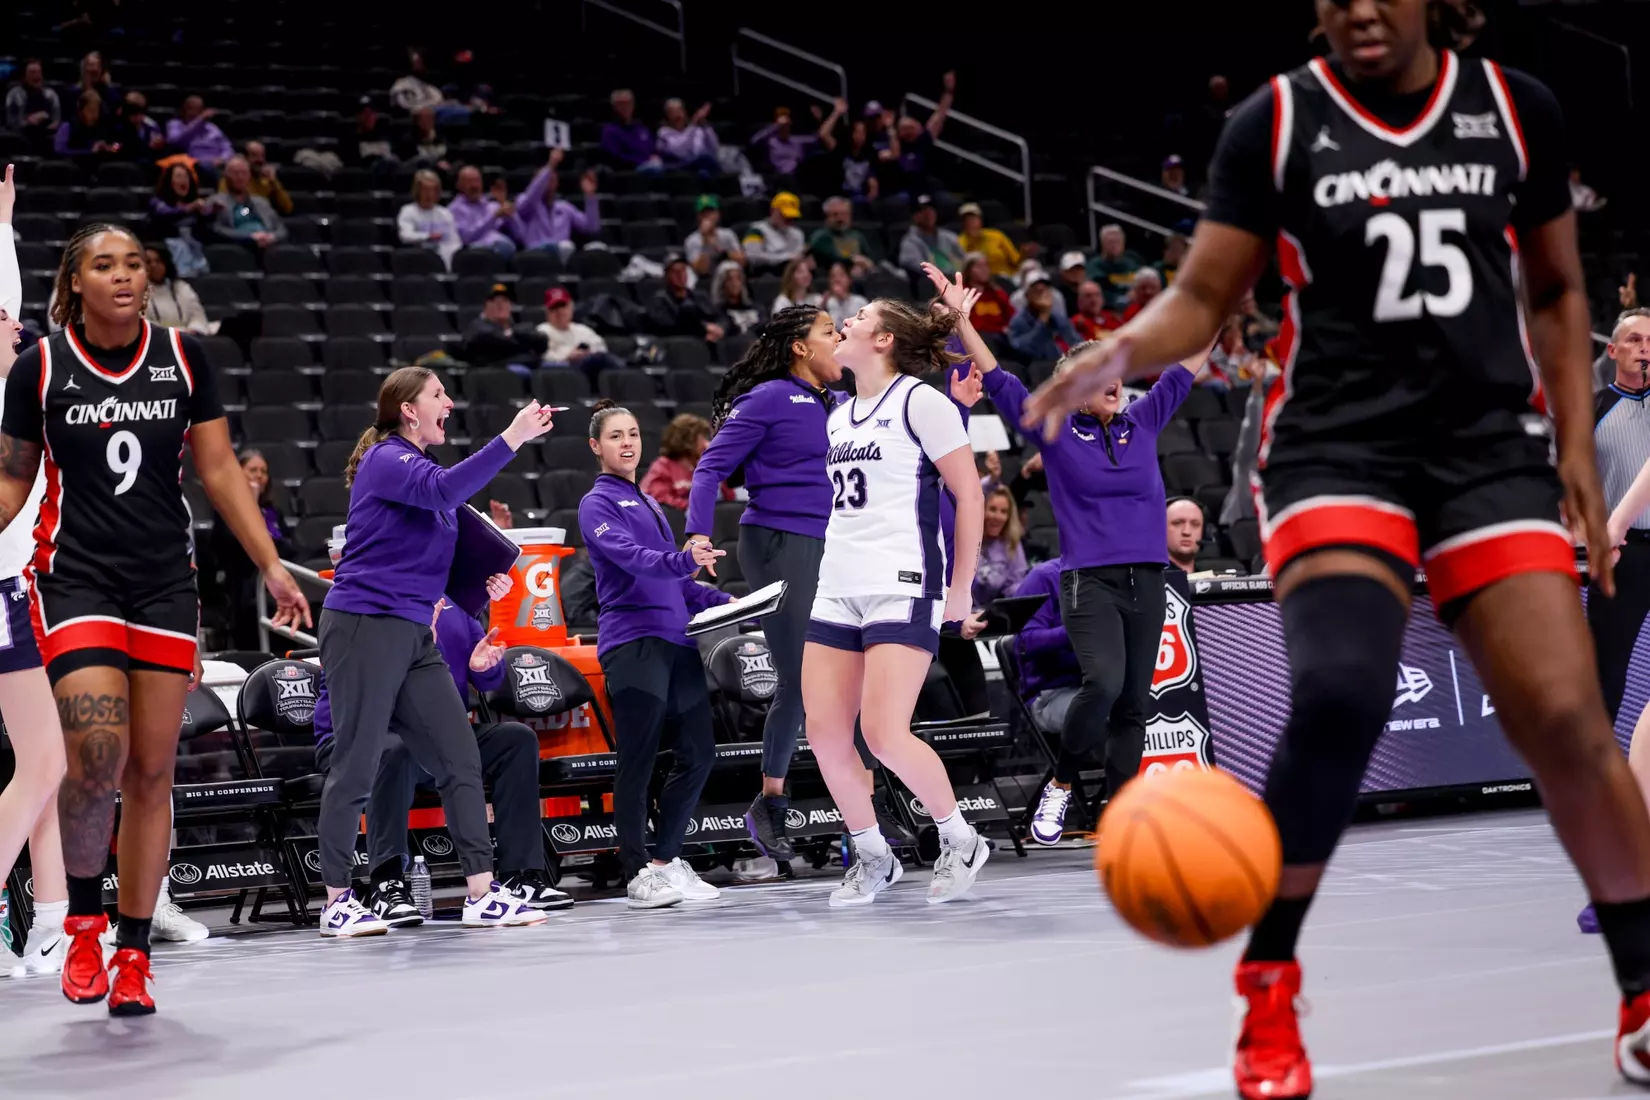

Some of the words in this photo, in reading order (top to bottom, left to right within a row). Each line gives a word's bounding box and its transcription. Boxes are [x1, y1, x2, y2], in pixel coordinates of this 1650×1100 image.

[1314, 159, 1497, 207] CINCINNATI
[1364, 208, 1474, 323] 25
[148, 365, 178, 382] XII
[65, 396, 177, 425] CINCINNATI
[105, 430, 142, 496] 9
[826, 440, 883, 466] Wildcats
[832, 466, 868, 512] 23
[525, 561, 555, 598] G
[1155, 631, 1176, 671] 6
[739, 653, 774, 674] XII
[515, 665, 552, 687] XII
[275, 678, 316, 699] XII
[958, 730, 1005, 739] CONFERENCE
[1144, 730, 1195, 751] HILLIPS
[720, 748, 764, 757] CONFEREN
[217, 786, 274, 796] CONFERENCE
[958, 796, 997, 811] state
[701, 815, 745, 831] Allsta
[808, 808, 844, 824] Allst
[584, 823, 618, 840] Allst
[205, 861, 276, 880] Allstate
